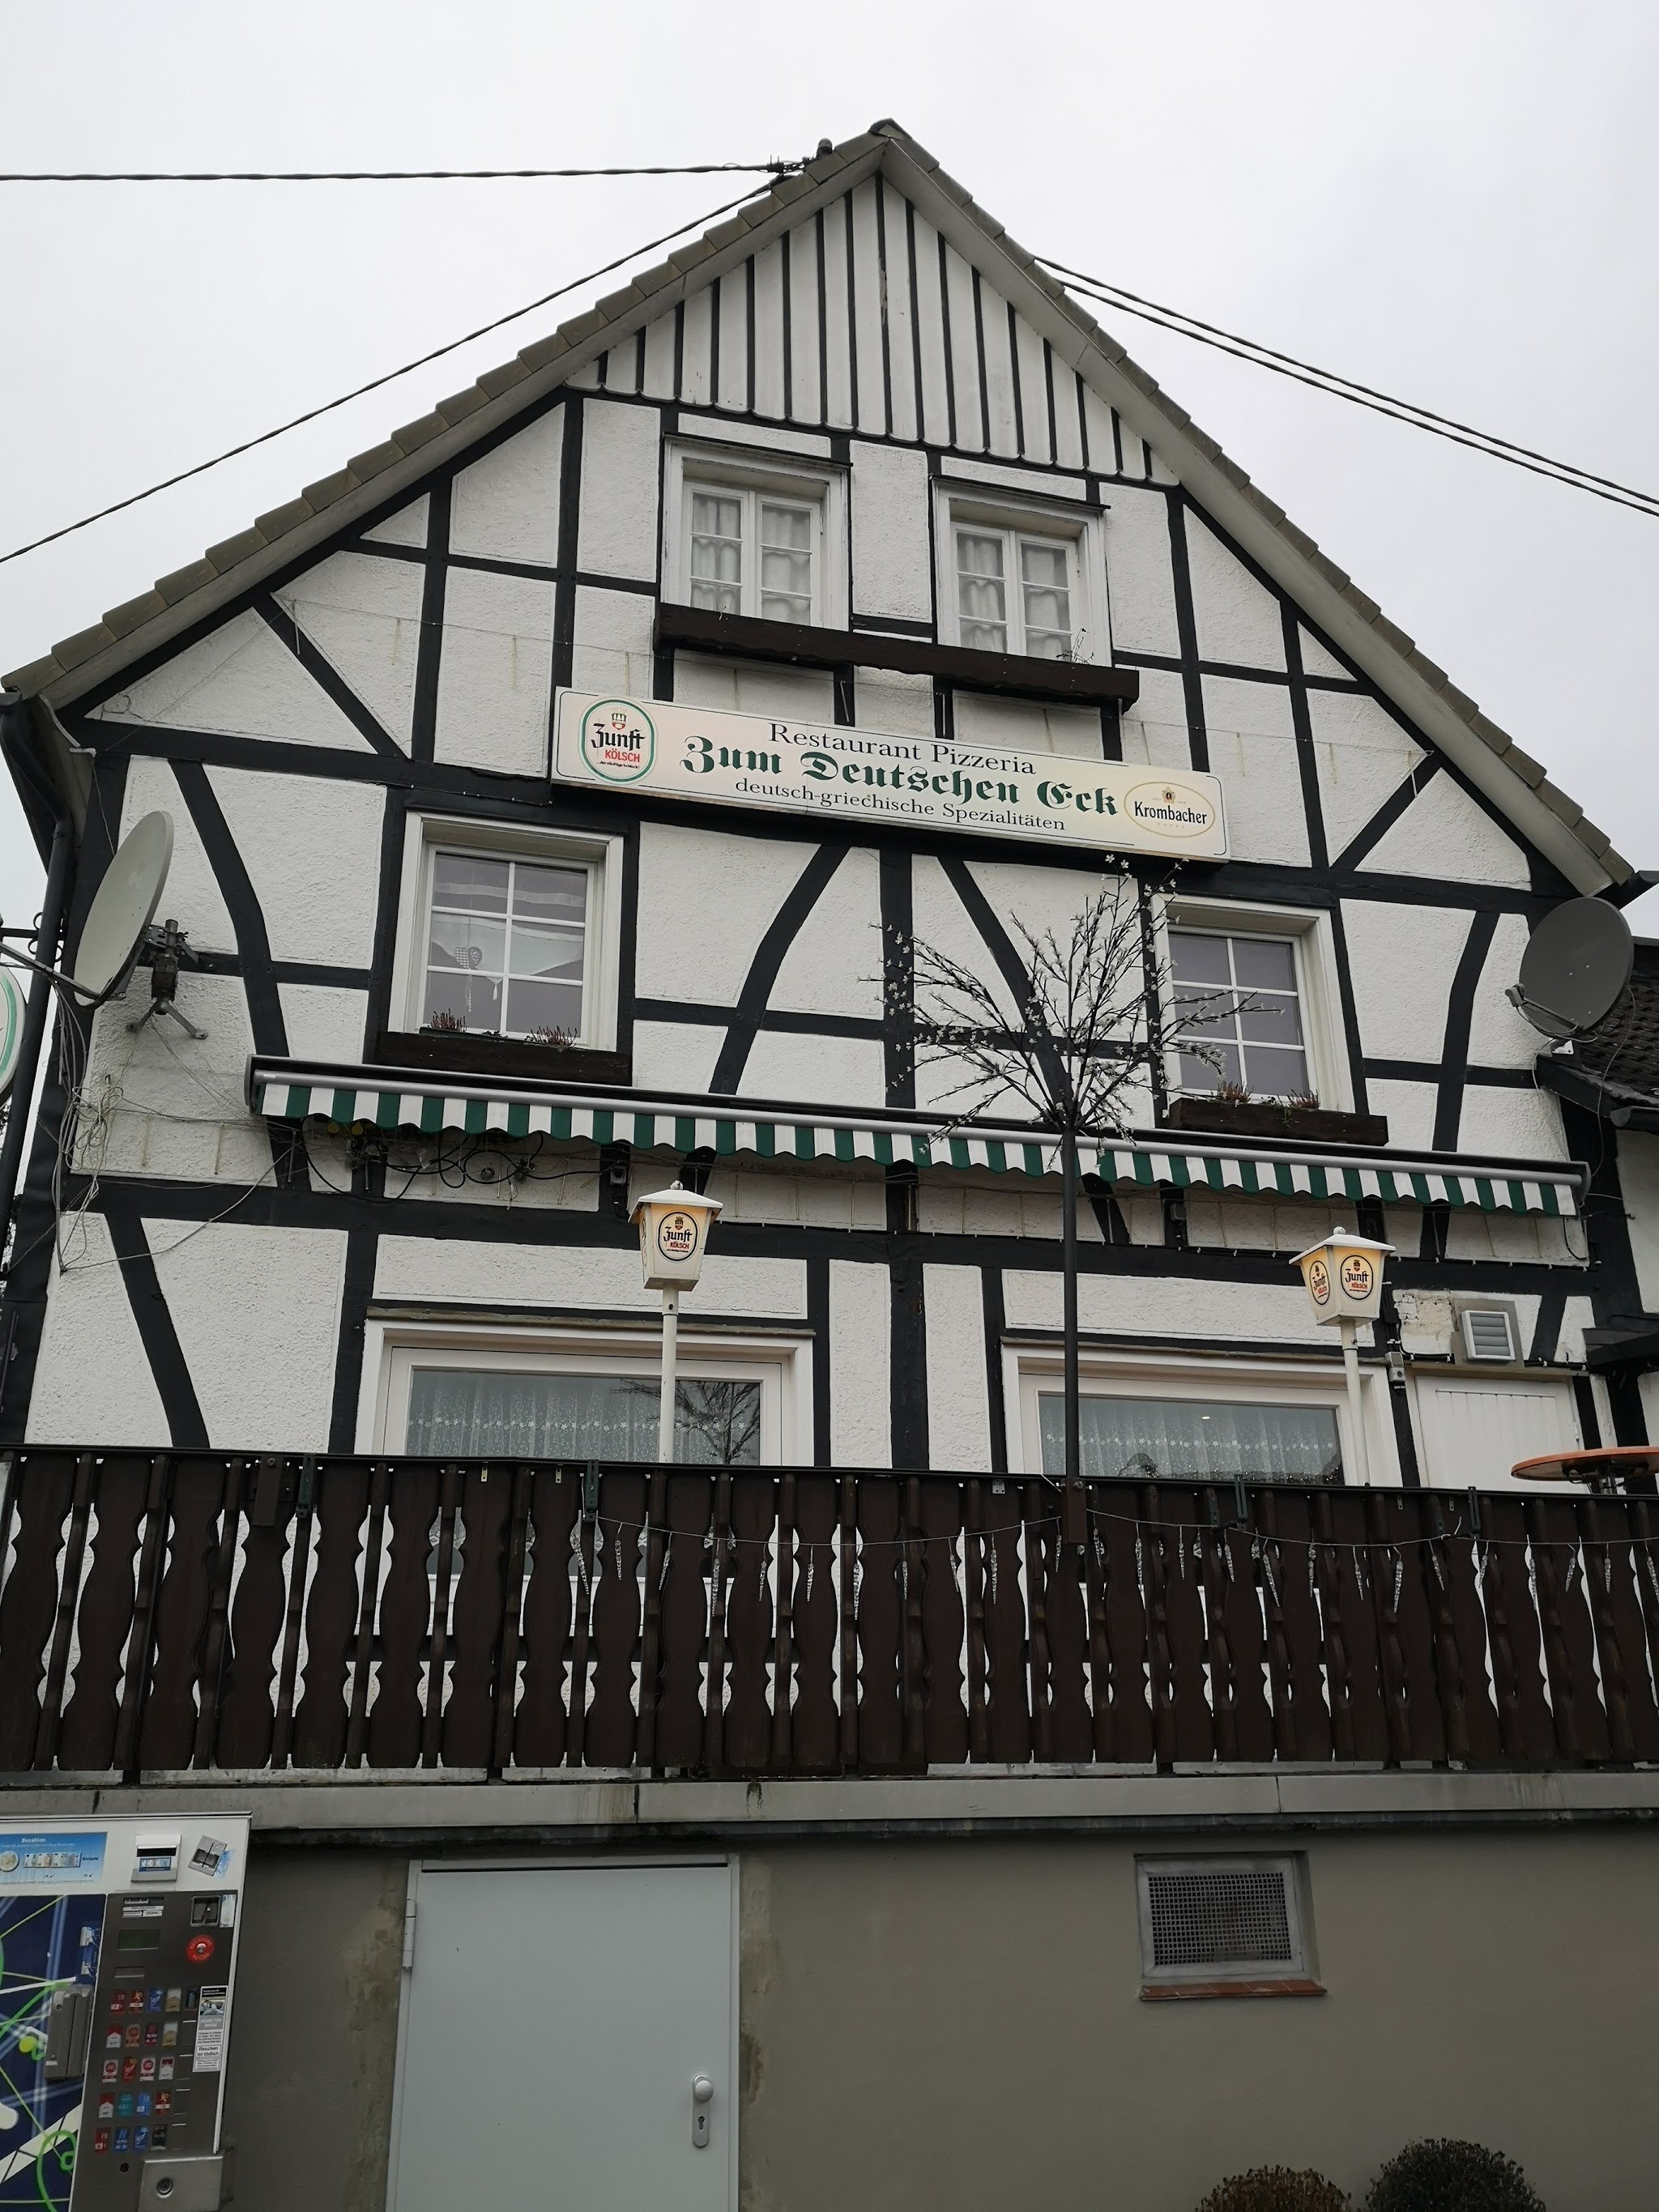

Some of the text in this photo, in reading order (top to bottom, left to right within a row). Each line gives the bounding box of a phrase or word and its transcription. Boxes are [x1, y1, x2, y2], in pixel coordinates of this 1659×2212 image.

[591, 723, 646, 751] Zunft
[769, 723, 1036, 774] Restaurant Pizzeria
[605, 748, 640, 762] KÖLSCH
[680, 735, 1118, 816] Zum Deutschen Eck
[736, 778, 1065, 830] deutsch-griechische Spezialitäten
[1134, 801, 1207, 824] Krombacher
[663, 1226, 693, 1242] Zunft
[670, 1241, 689, 1249] KÖLSCH
[1345, 1268, 1369, 1283] Zunft
